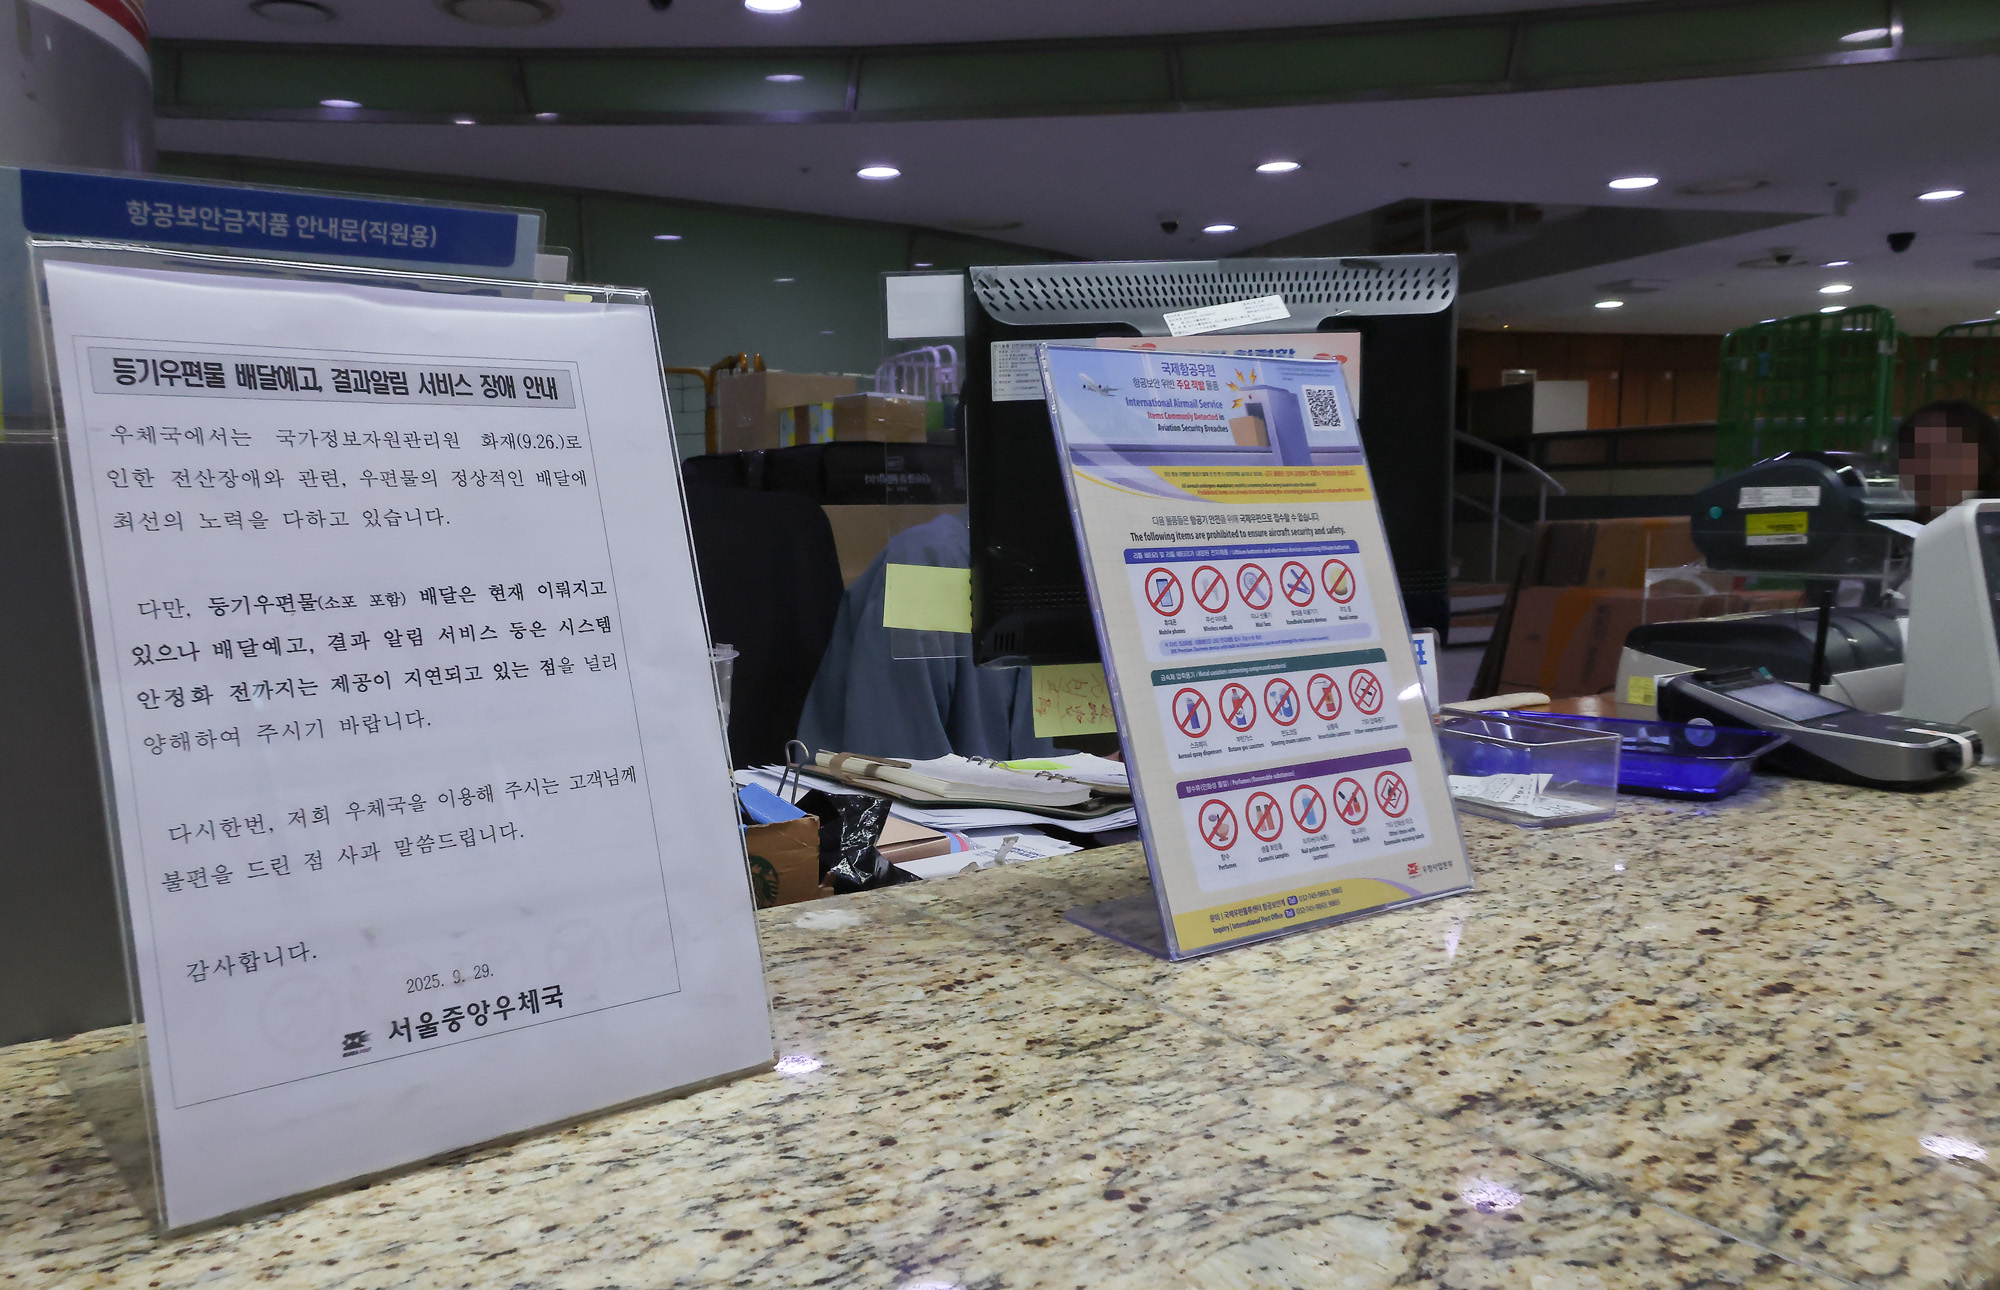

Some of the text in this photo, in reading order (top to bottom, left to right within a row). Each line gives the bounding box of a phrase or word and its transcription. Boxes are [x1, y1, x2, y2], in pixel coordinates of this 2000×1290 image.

[127, 200, 436, 247] 항공보안금지품 안내문(직원용)
[113, 357, 558, 400] 등기우편물 배달예고, 결과알림 서비스 장애 안내
[1161, 361, 1216, 377] 국제항공우편
[1133, 377, 1160, 388] 항공보안
[1161, 379, 1175, 389] 위반
[1176, 380, 1191, 390] 주요
[1125, 397, 1223, 409] International Airmail Service
[1158, 424, 1180, 432] Aviation
[1181, 424, 1203, 433] Security
[1164, 412, 1193, 421] Commonly
[110, 425, 582, 450] 우체국에서는 국가정보자원관리원 화재(9.26.)로
[107, 468, 586, 488] 인한 전산장애와 관련, 우편물의 정상적인 배달에
[114, 508, 450, 532] 최선의 노력을 다하고 있습니다.
[1152, 516, 1165, 526] 다음
[1190, 515, 1208, 525] 항공기
[1130, 532, 1143, 541] The
[1144, 532, 1176, 542] following
[1176, 531, 1194, 540] items
[1195, 532, 1205, 540] are
[1206, 530, 1239, 541] prohibited
[1240, 530, 1247, 538] to
[1268, 528, 1290, 537] aircraft
[1291, 527, 1314, 537] security
[1314, 526, 1326, 535] and
[1326, 526, 1346, 535] safety.
[137, 580, 607, 620] 다만, 등기우편물(소포 포함) 배달은 현재 이뤄지고
[132, 616, 611, 666] 있으나 배달예고, 결과 알림 서비스 등은 시스템
[137, 653, 617, 709] 안정화 전까지는 제공이 지연되고 있는 점을 널리
[144, 709, 430, 755] 양해하여 주시기 바랍니다.
[168, 766, 636, 844] 다시한번, 저희 우체국을 이용해 주시는 고객님께
[161, 822, 523, 892] 불편을 드린 점 사과 말씀드립니다.
[1218, 863, 1237, 871] Perfumes
[1422, 860, 1453, 873] 우정사업본부
[1213, 925, 1229, 934] Inquiry
[1231, 917, 1260, 929] International
[1261, 915, 1271, 923] Post
[187, 942, 316, 983] 감사합니다.
[406, 964, 493, 993] 2025. 9. 29.
[389, 985, 563, 1042] 서울중앙우체국
